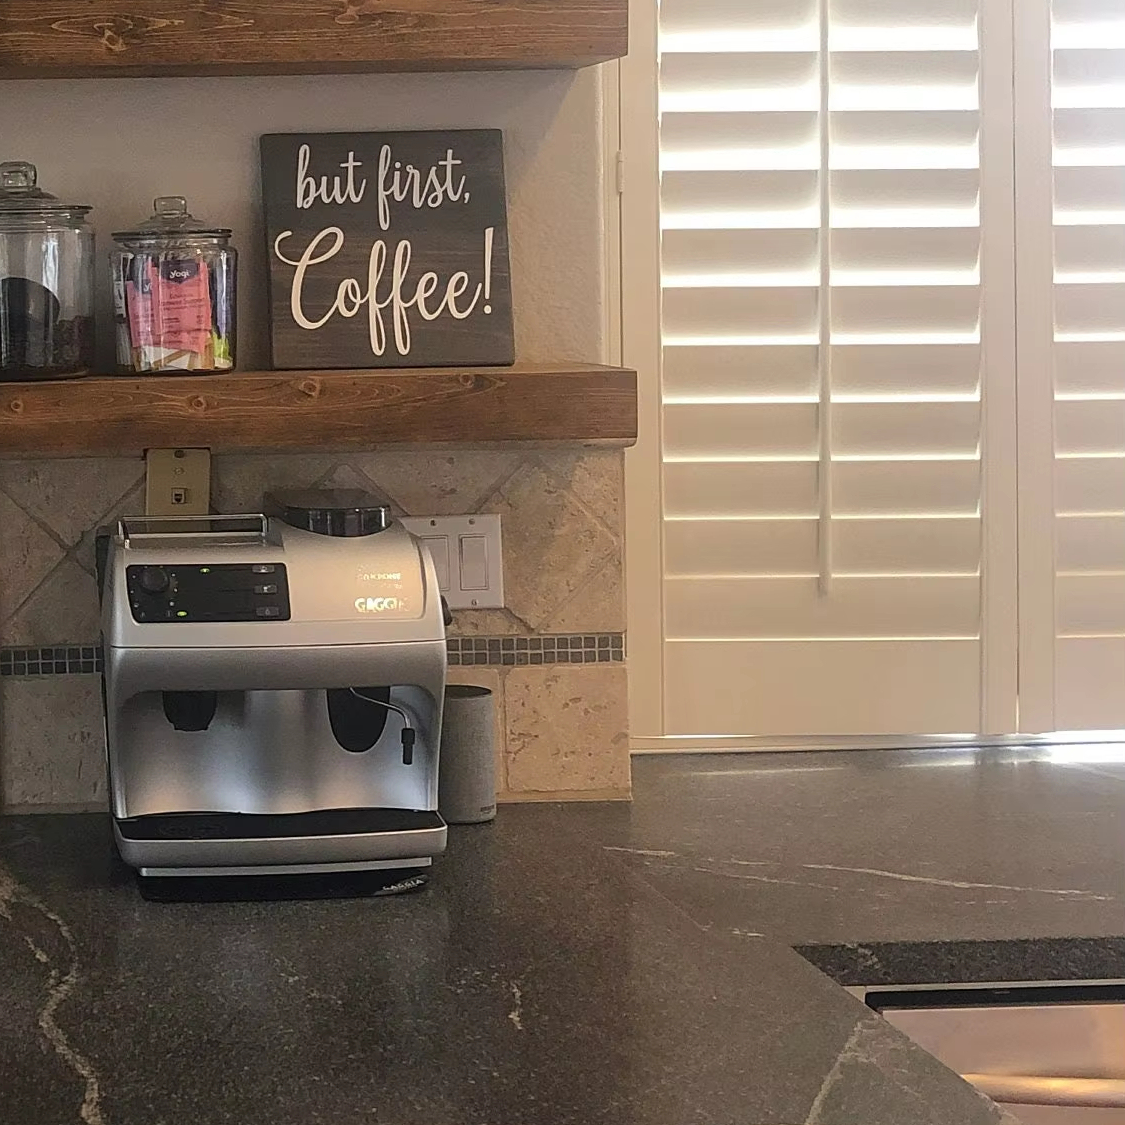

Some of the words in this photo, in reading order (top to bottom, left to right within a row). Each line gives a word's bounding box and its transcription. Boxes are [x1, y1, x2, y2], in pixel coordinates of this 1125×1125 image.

[296, 144, 366, 209] but
[378, 144, 470, 231] first,
[169, 269, 190, 279] yogi
[274, 226, 494, 356] Coffee!
